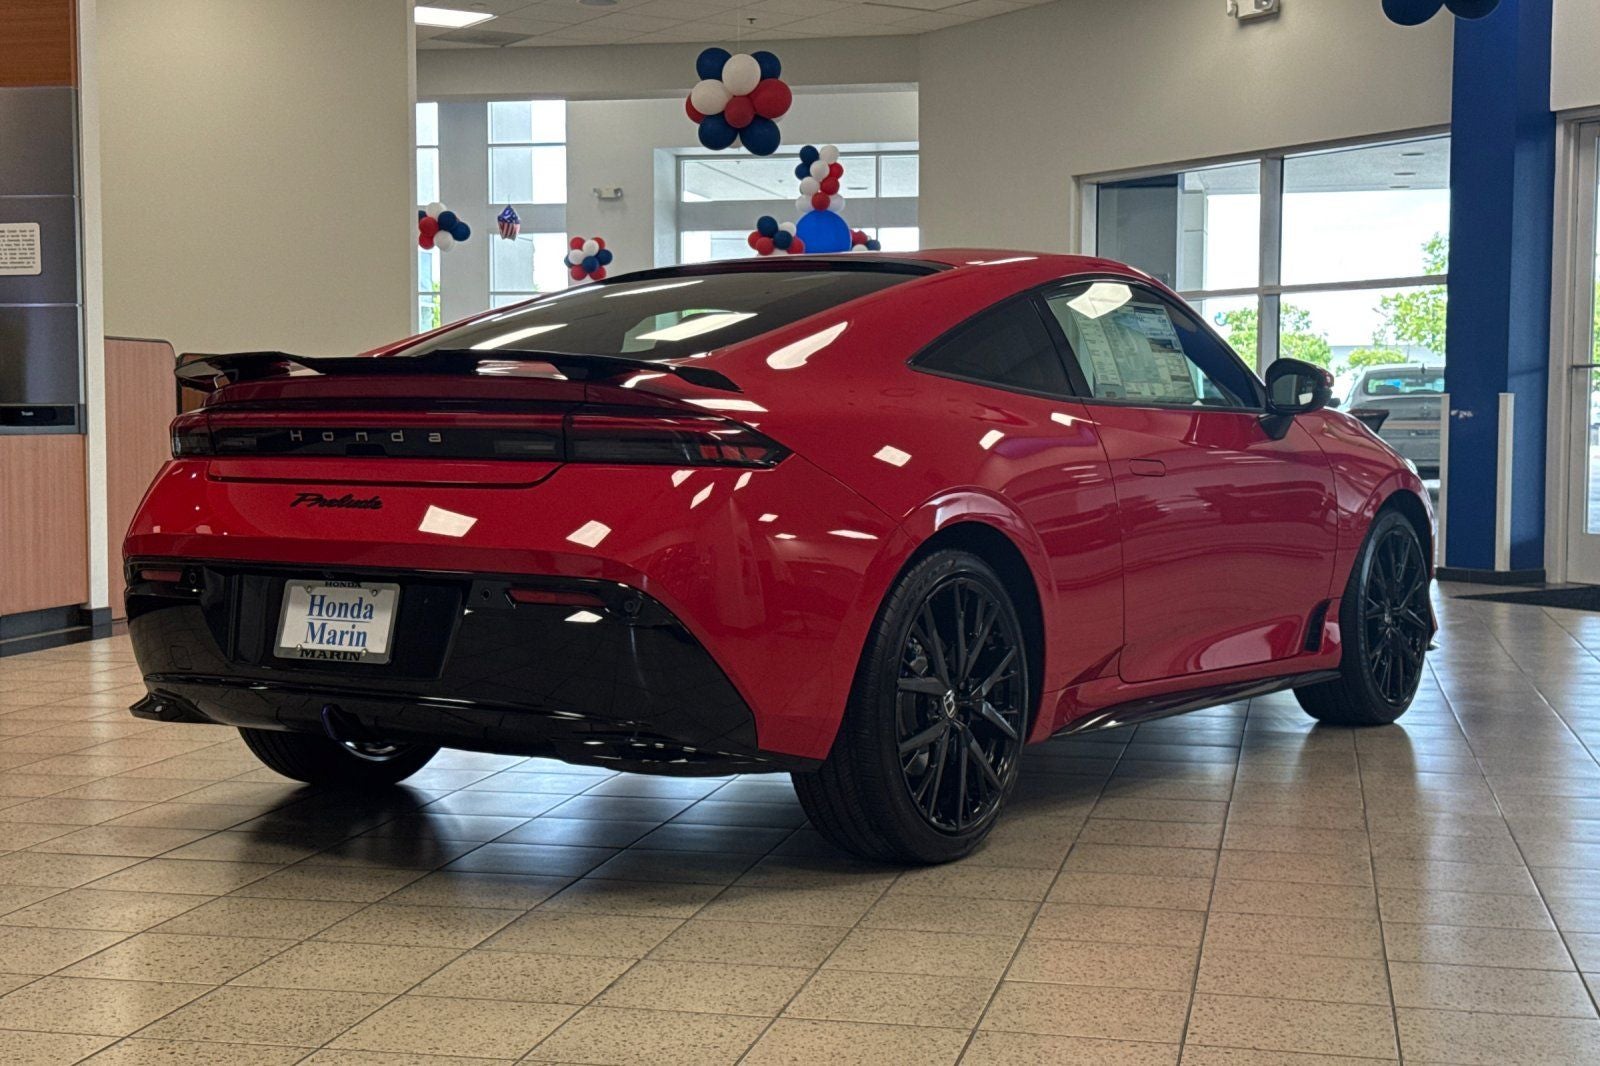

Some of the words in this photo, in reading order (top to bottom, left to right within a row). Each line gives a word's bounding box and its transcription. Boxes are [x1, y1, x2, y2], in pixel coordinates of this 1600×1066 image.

[290, 430, 442, 443] Honda
[289, 492, 383, 510] Prelude
[307, 594, 375, 620] Honda
[303, 622, 368, 648] Marin
[300, 648, 361, 661] MARIN
